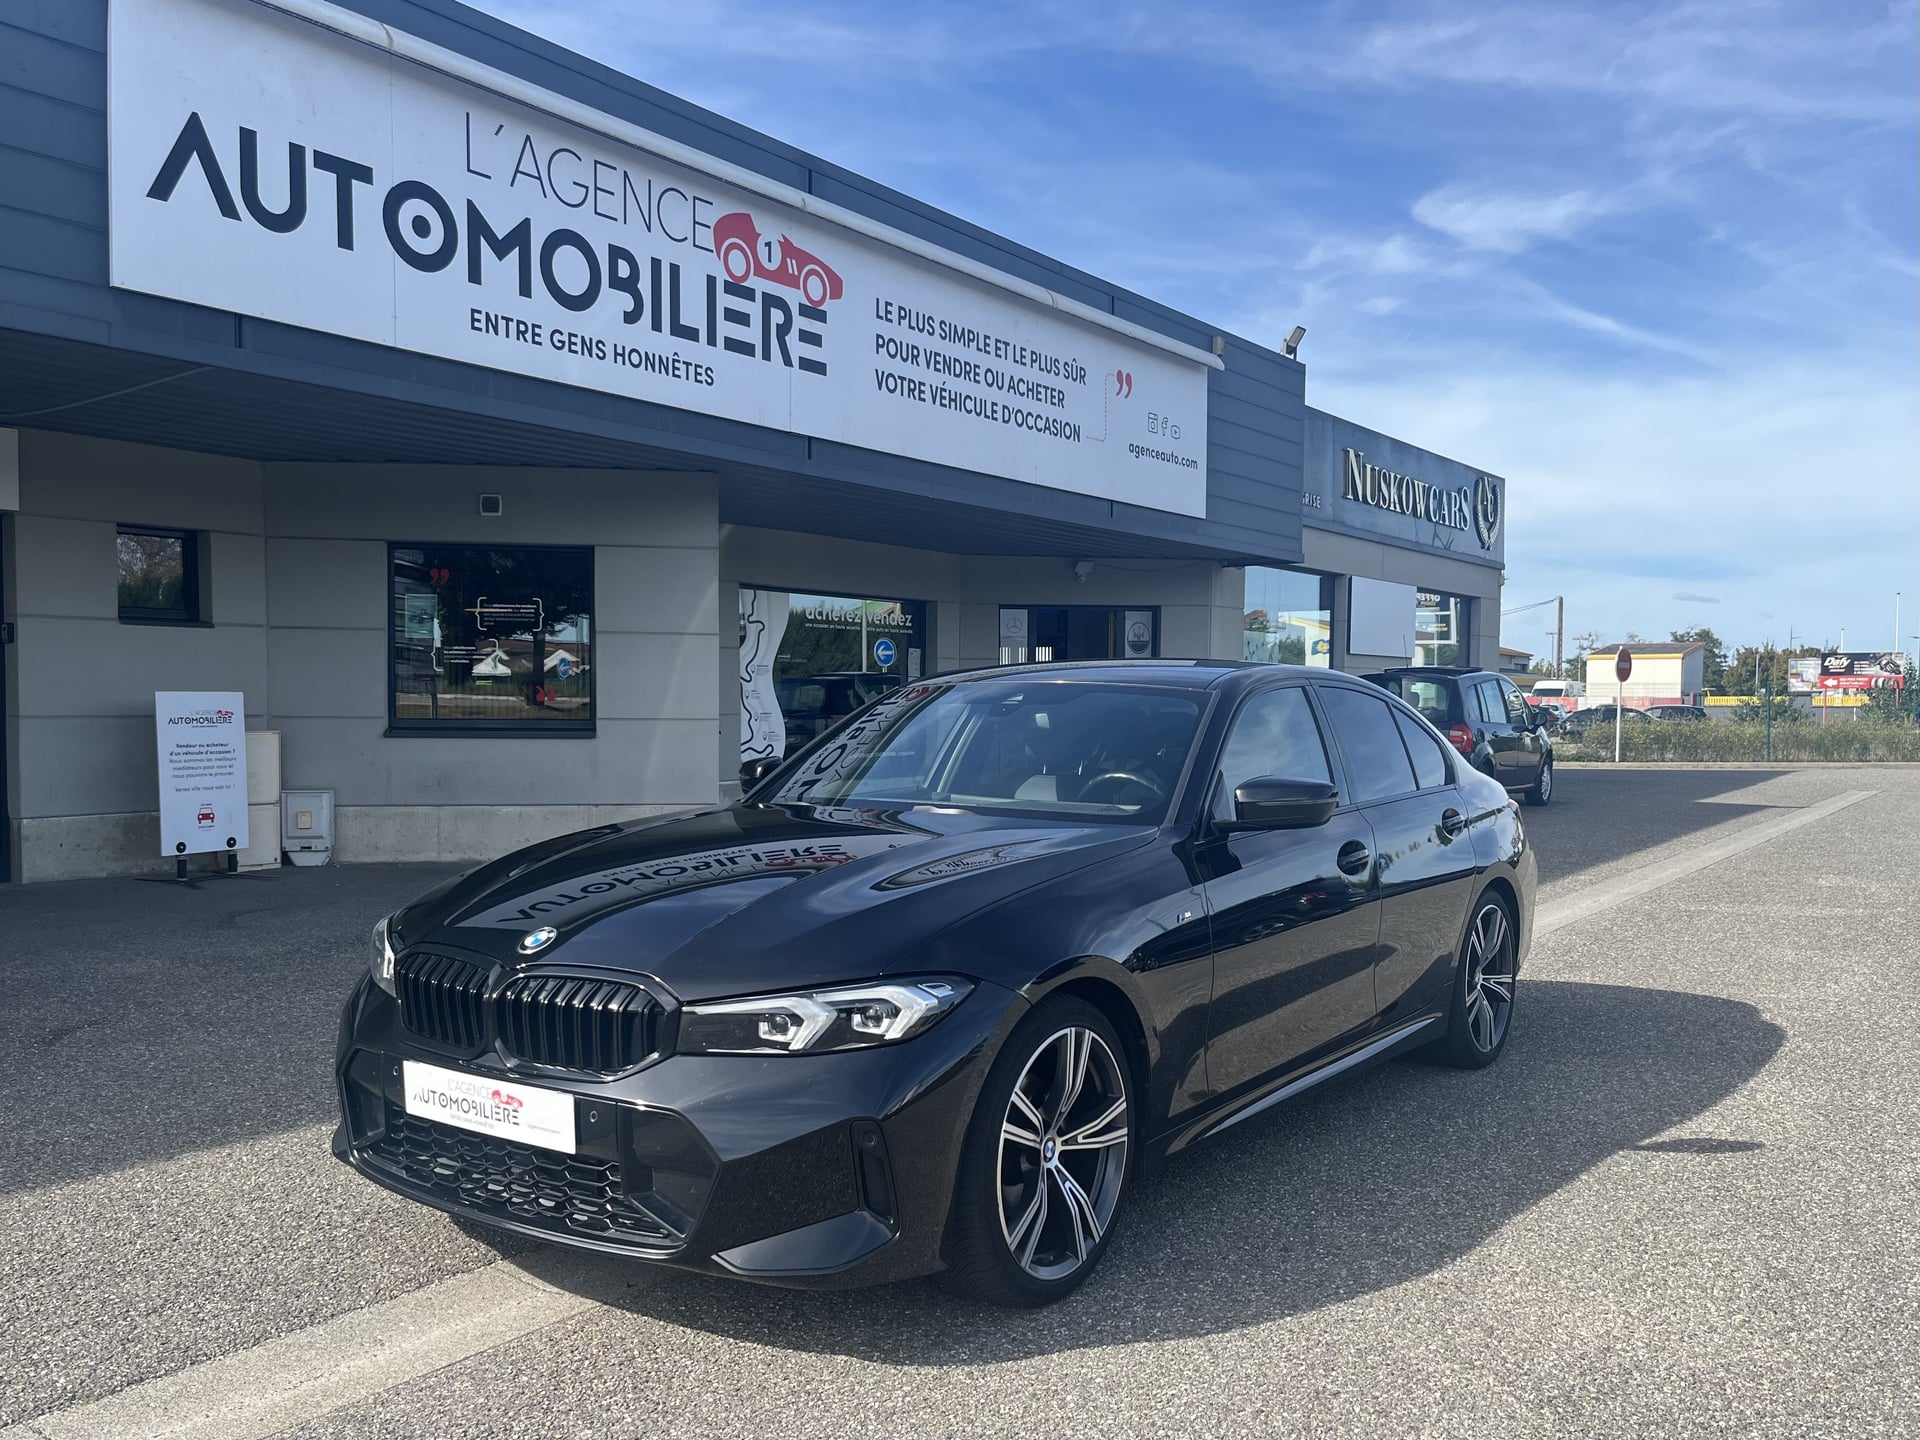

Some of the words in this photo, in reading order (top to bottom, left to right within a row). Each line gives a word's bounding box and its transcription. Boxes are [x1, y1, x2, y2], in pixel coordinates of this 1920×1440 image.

[466, 112, 714, 253] L'AGENCE
[470, 308, 543, 346] ENTRE
[549, 328, 607, 361] GENS
[613, 343, 715, 387] HONNÊTES
[875, 333, 920, 367] POUR
[924, 348, 981, 384] VENDRE
[984, 368, 1004, 392] OU
[1007, 375, 1065, 409] ACHETER
[876, 297, 893, 323] LE
[898, 305, 935, 337] PLUS
[939, 320, 991, 355] SIMPLE
[994, 335, 1010, 361] ET
[1013, 342, 1027, 367] LE
[1030, 348, 1060, 378] PLUS
[1063, 358, 1087, 386] SÛR
[875, 368, 926, 403] VOTRE
[930, 381, 998, 422] VÉHICULE
[1002, 404, 1081, 443] D'OCCASION
[1128, 443, 1198, 470] agenceauto.com
[1824, 656, 1851, 669] Dafy
